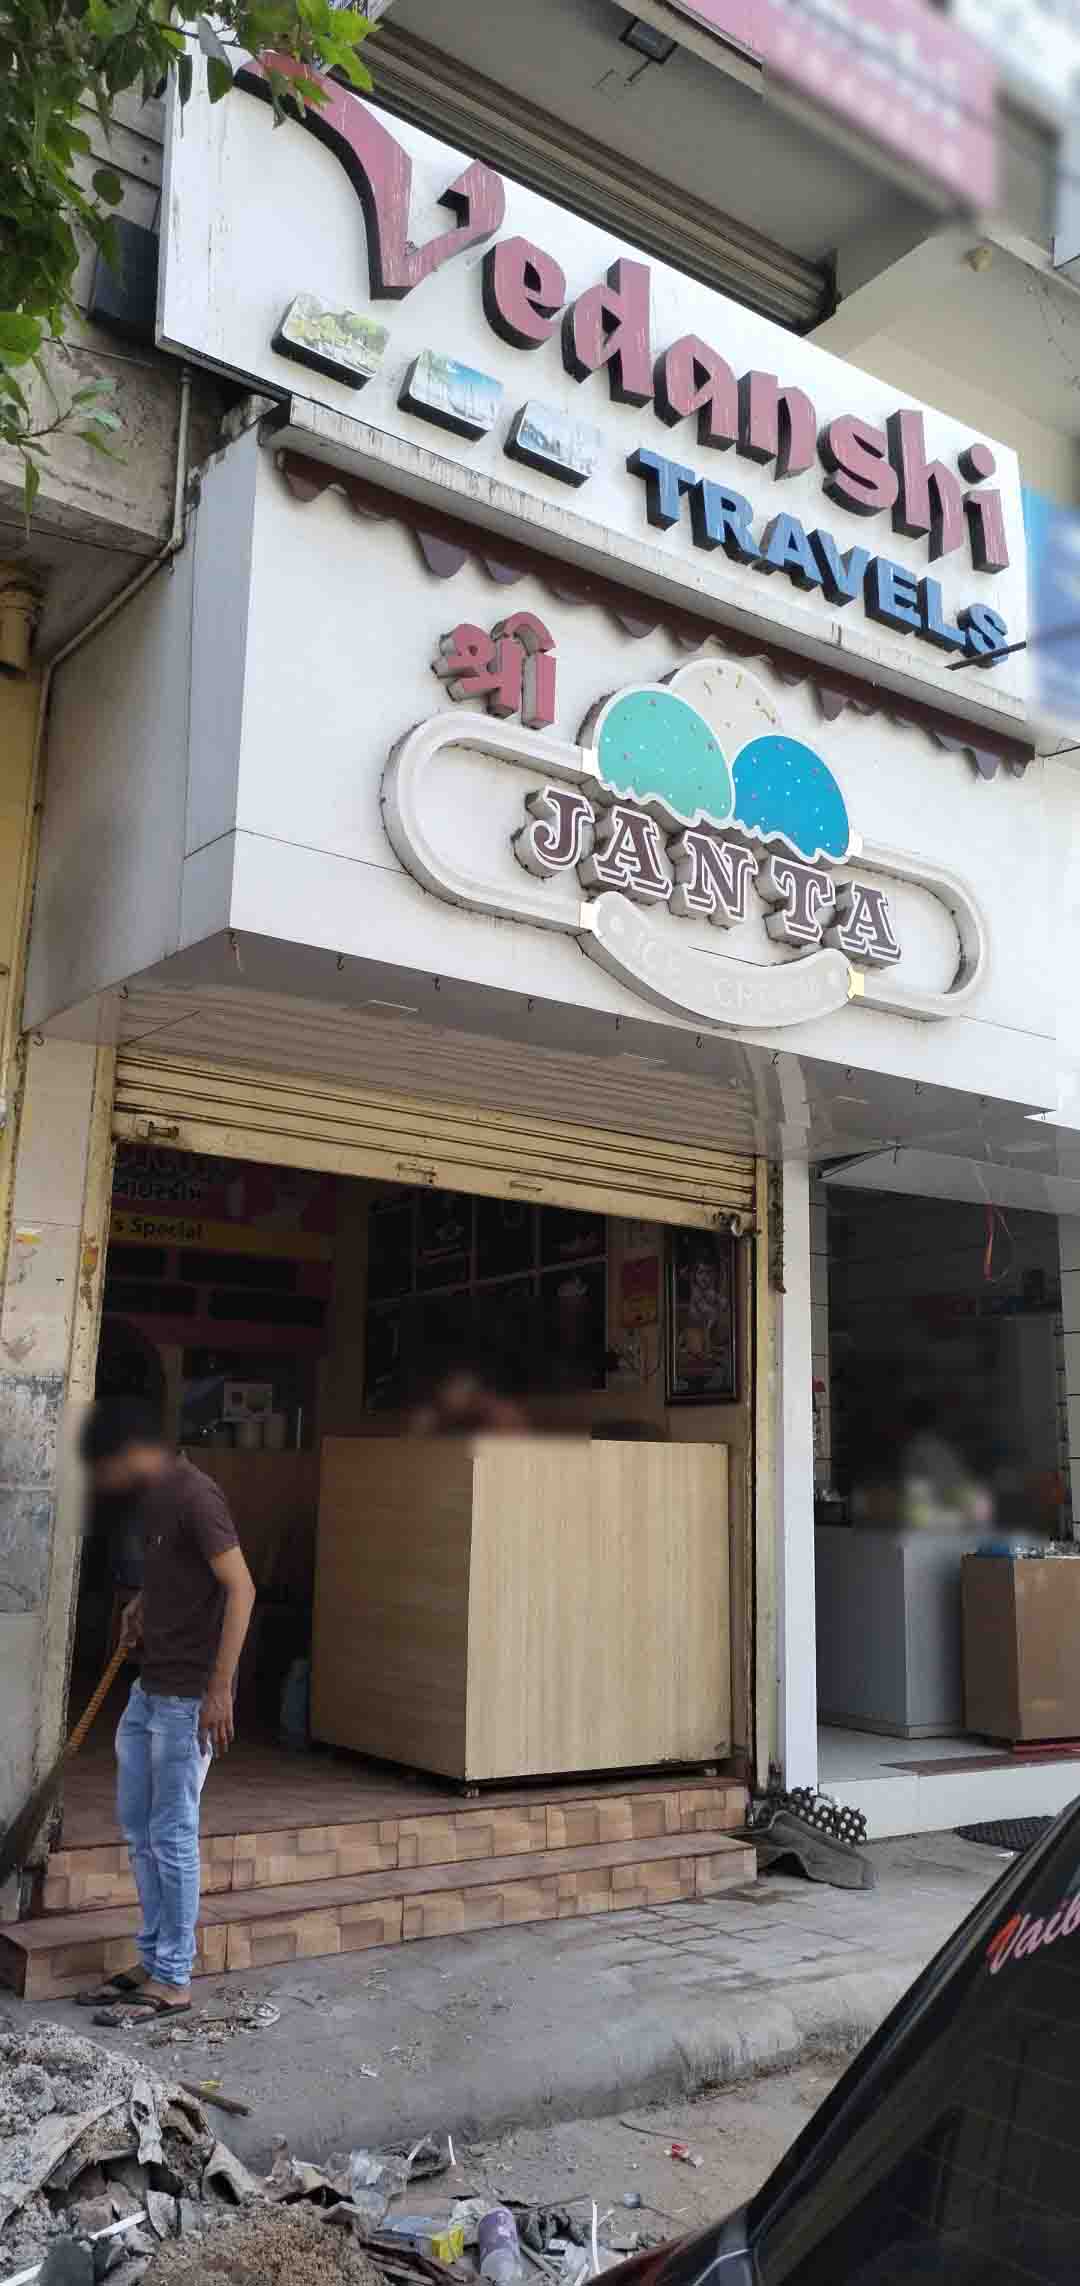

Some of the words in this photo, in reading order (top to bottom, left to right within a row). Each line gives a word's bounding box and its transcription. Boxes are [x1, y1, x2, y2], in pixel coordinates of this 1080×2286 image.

[234, 48, 1009, 572] Vedanshi
[627, 448, 1008, 668] TRAVELS
[514, 785, 902, 969] JANTA
[130, 1217, 203, 1239] Special
